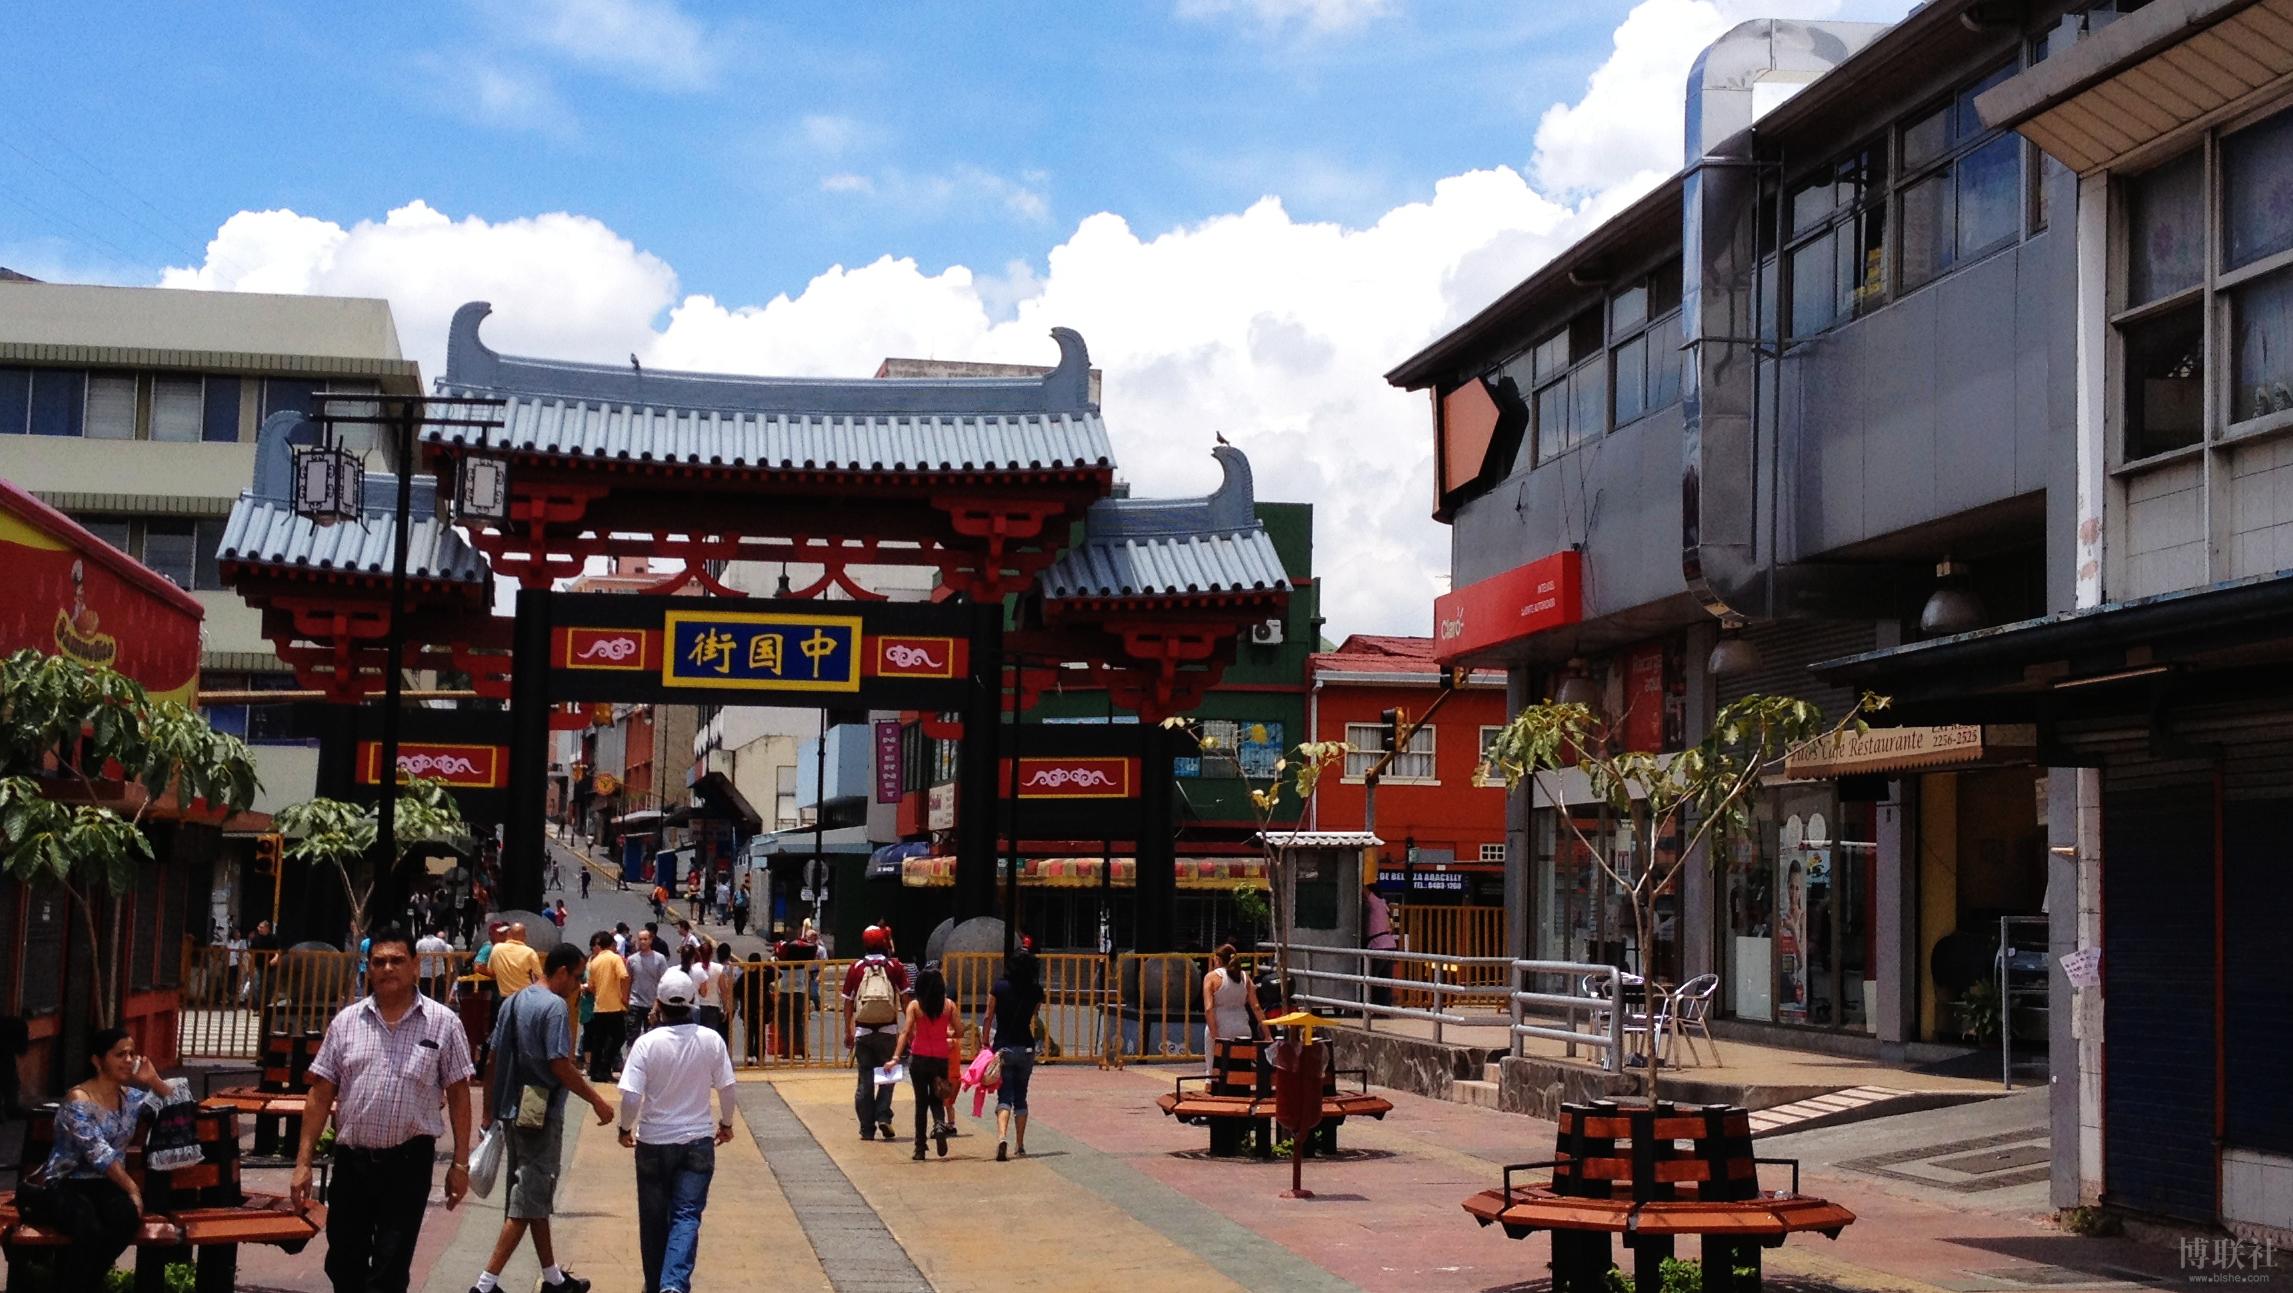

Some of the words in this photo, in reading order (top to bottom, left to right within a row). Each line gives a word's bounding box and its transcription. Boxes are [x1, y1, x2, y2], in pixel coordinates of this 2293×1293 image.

[1441, 613, 1463, 641] Claro
[1848, 730, 1924, 758] Restaurante
[882, 727, 897, 798] INTERNET
